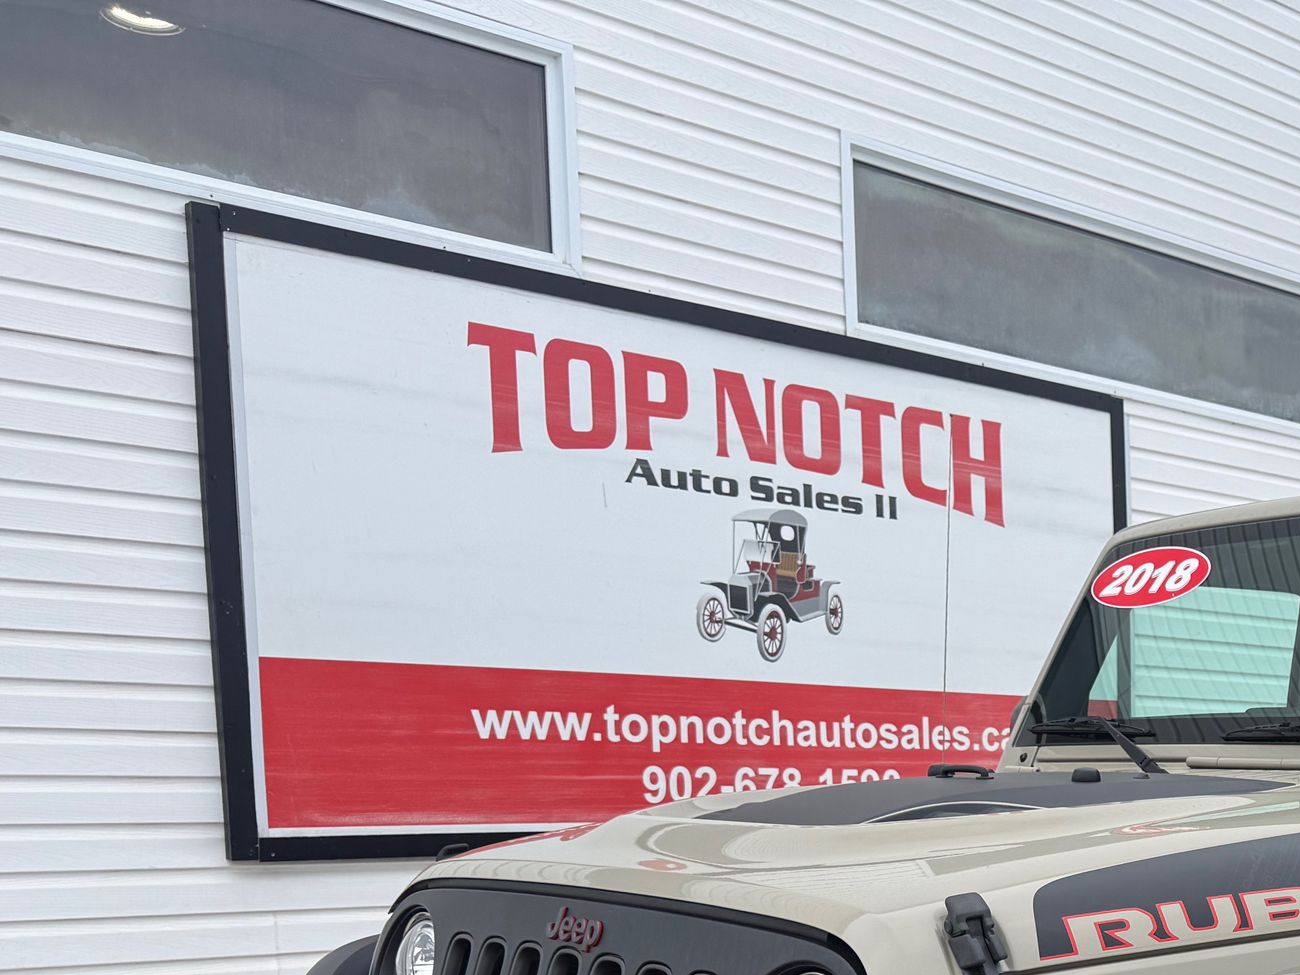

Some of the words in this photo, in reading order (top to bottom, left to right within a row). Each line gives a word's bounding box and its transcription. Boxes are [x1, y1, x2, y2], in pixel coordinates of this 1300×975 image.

[467, 321, 689, 454] TOP
[713, 368, 1006, 528] NOTCH
[626, 458, 739, 498] Auto
[750, 476, 864, 516] Sales
[874, 494, 898, 520] II
[1099, 558, 1199, 597] 2018
[546, 906, 604, 953] Jeep
